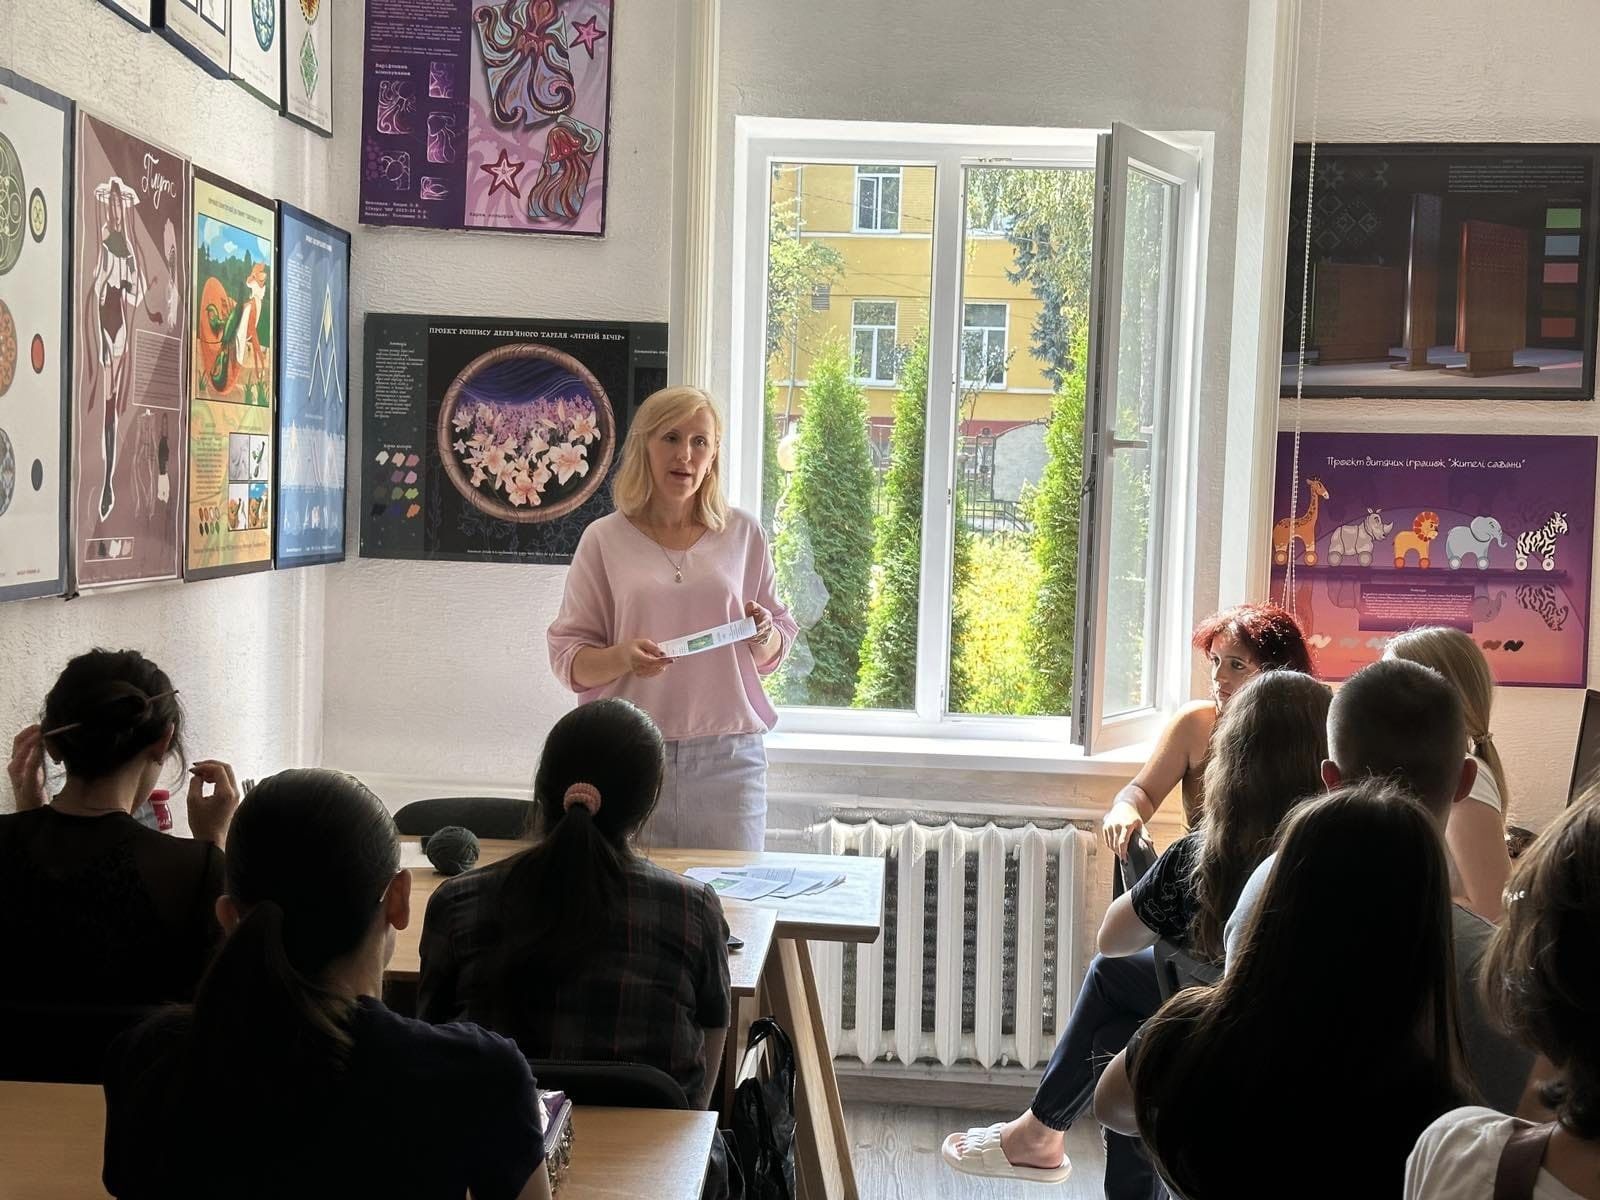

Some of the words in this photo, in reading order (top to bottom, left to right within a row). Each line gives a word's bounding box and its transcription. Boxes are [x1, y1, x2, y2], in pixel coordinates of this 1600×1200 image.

[459, 328, 491, 336] РОЗПИСУ
[540, 331, 568, 339] ТАРЕЛЯ
[1366, 455, 1404, 467] дитячих
[1405, 458, 1446, 470] іграшок
